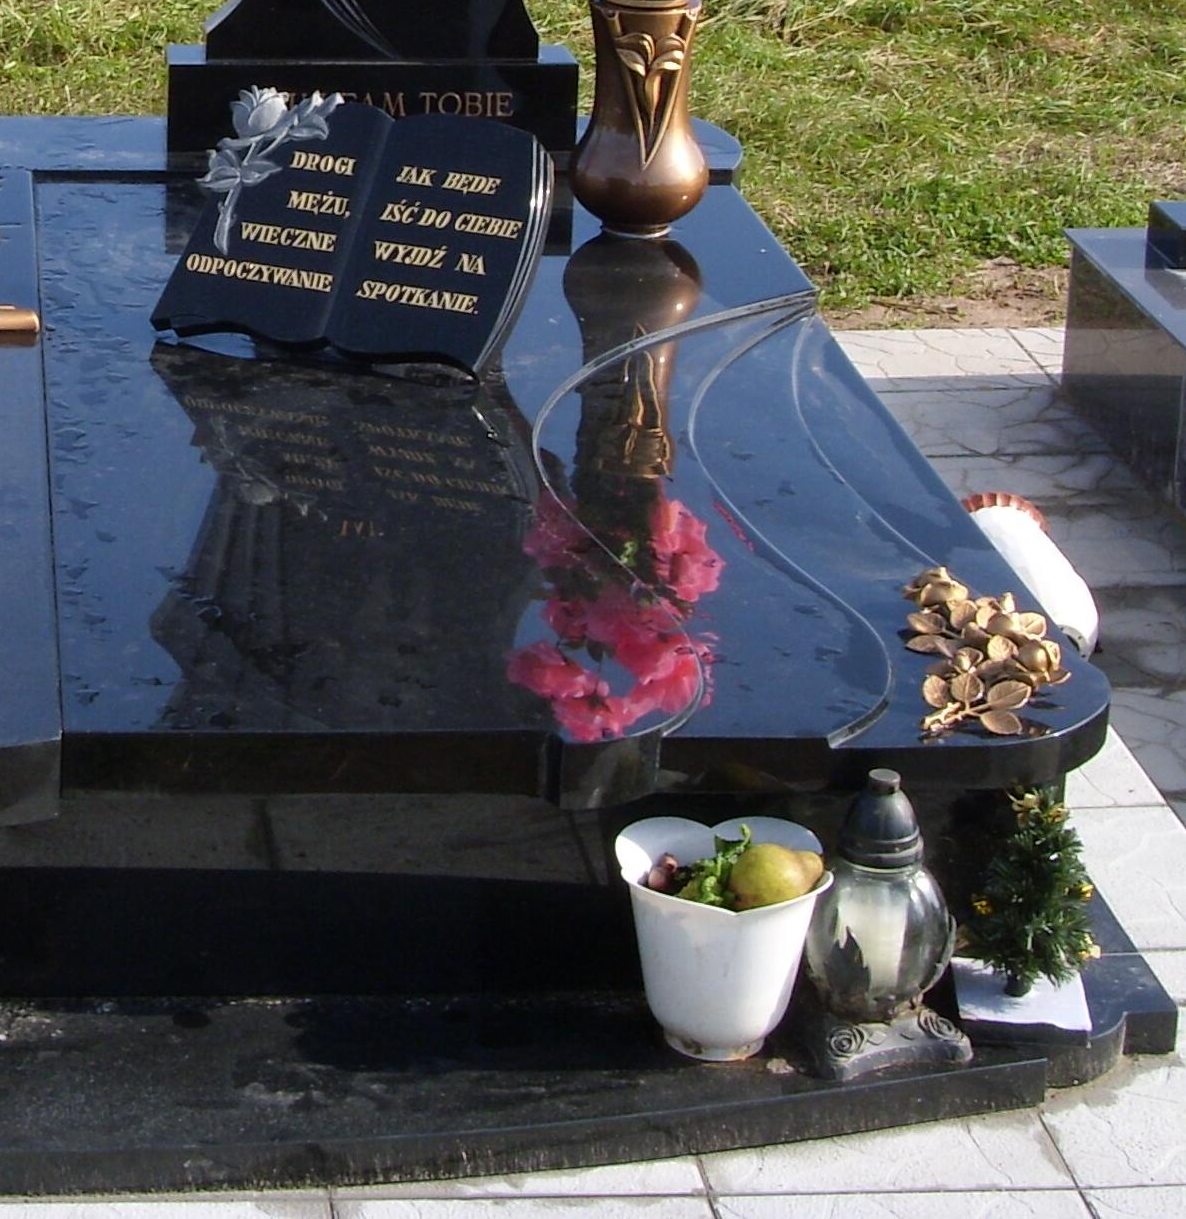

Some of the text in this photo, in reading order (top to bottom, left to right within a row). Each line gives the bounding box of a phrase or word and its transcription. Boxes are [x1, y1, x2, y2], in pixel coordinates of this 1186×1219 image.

[419, 92, 514, 117] TOBIE
[289, 151, 357, 176] DROGI
[396, 165, 438, 187] JAK
[287, 190, 351, 219] MĘŻU,
[380, 199, 523, 239] IŚĆ DO CIEBIE
[241, 222, 337, 252] WIECZNE
[186, 253, 334, 293] ODPOCZYWANIE
[374, 241, 486, 275] WYJDŹ NA
[356, 280, 479, 315] SPOTKANIE.
